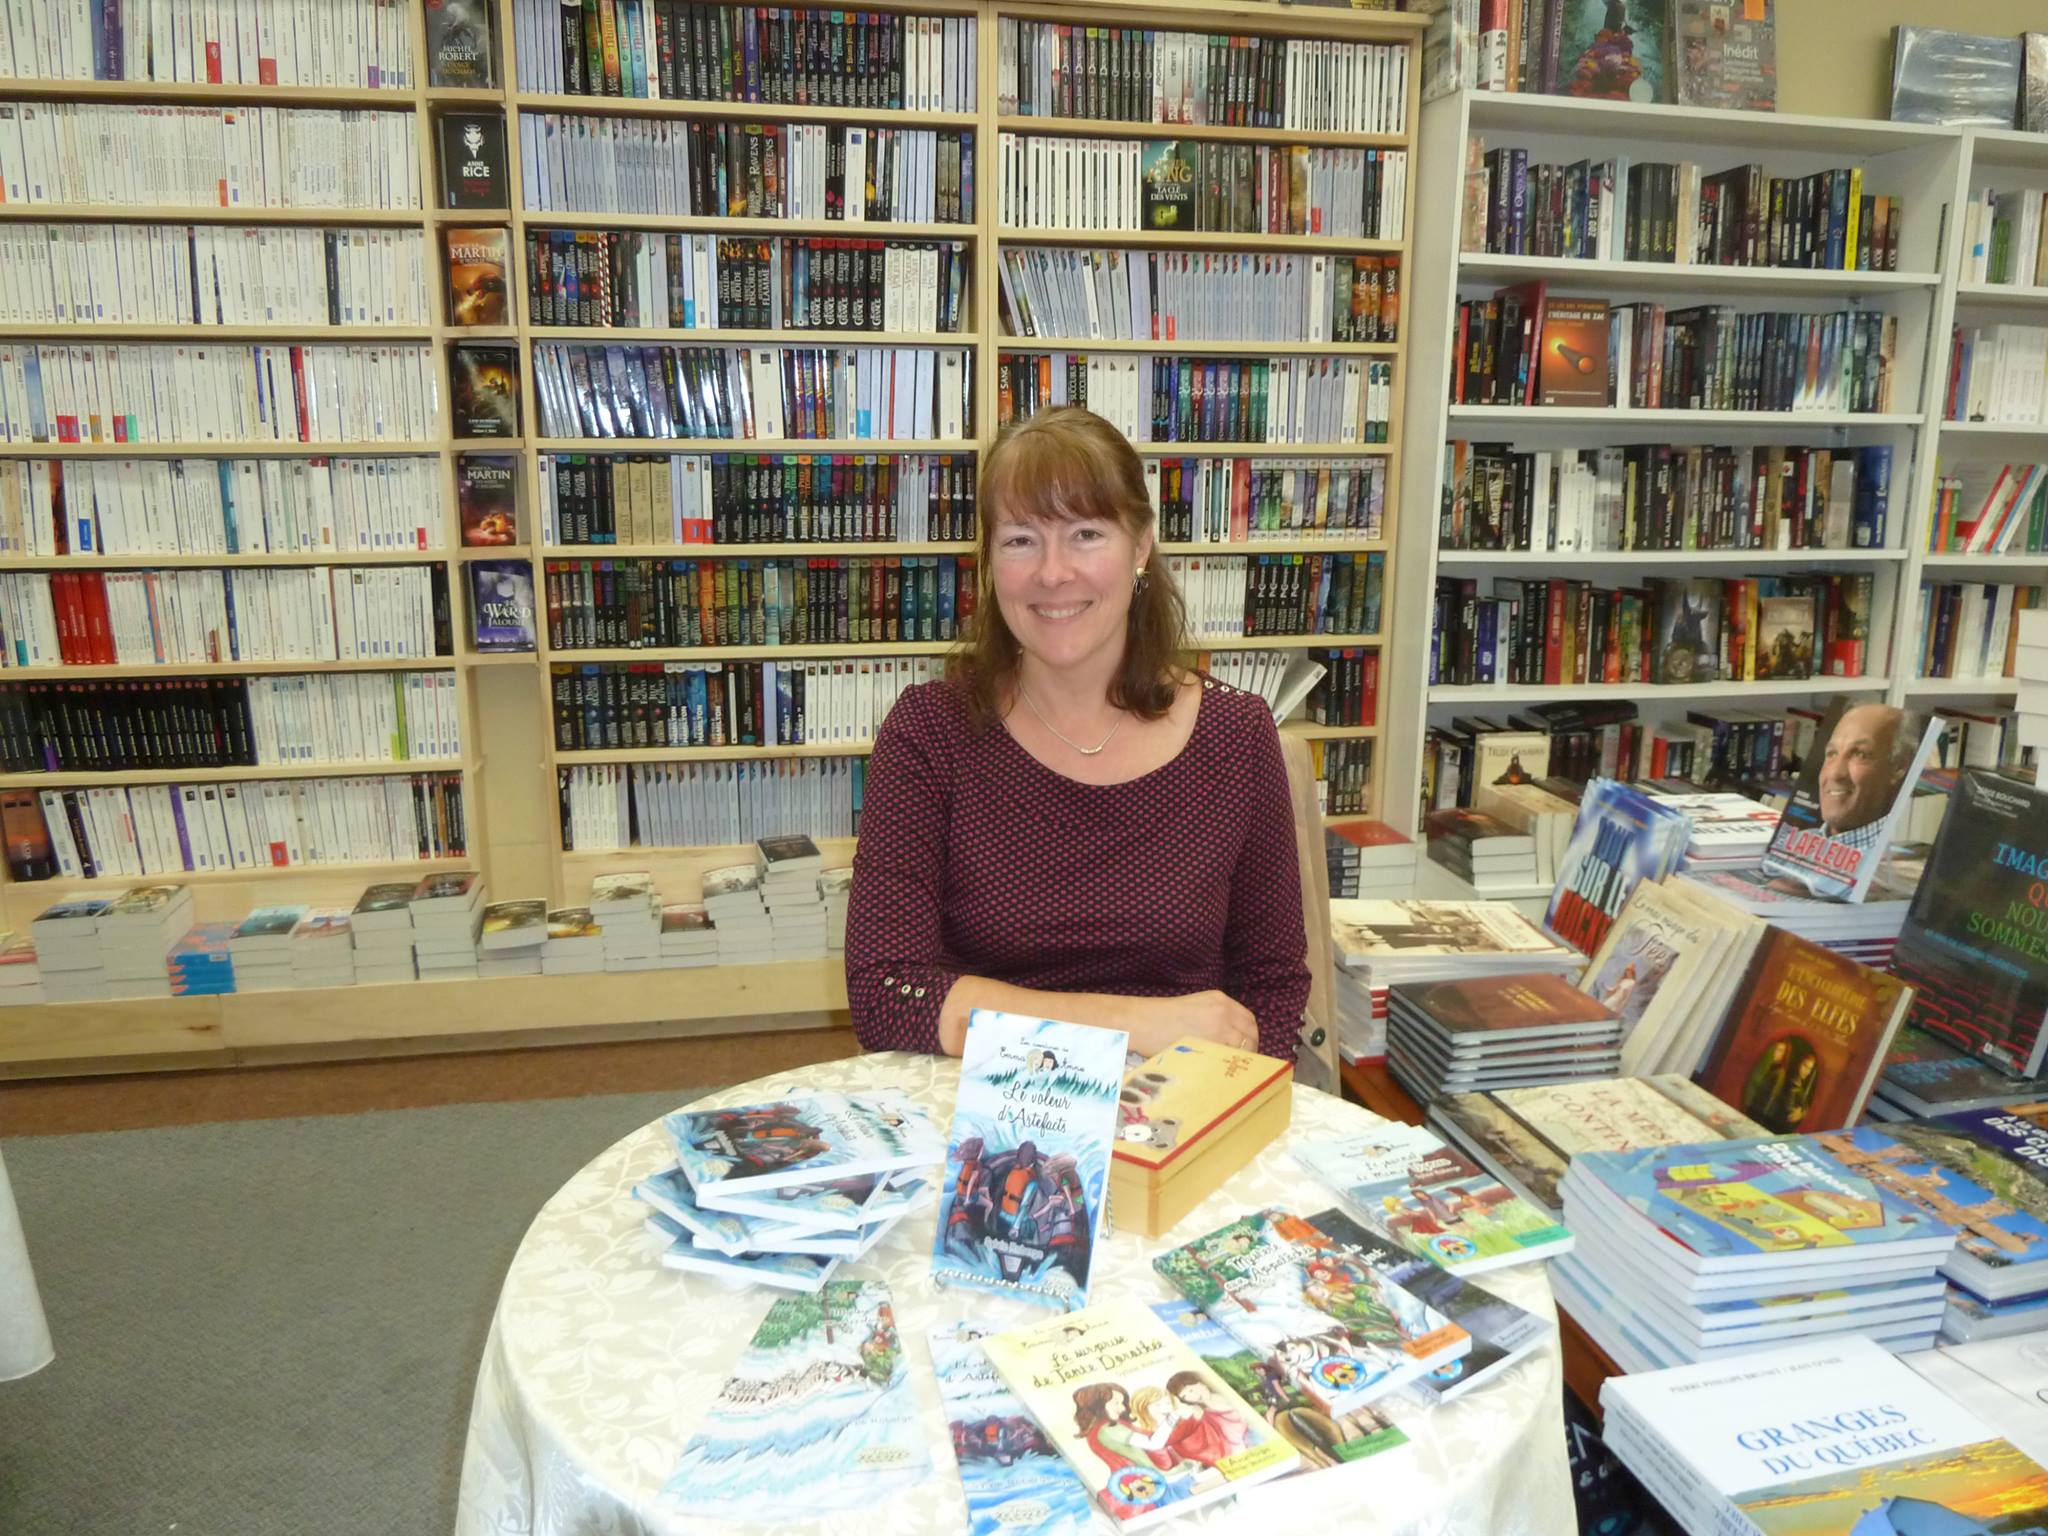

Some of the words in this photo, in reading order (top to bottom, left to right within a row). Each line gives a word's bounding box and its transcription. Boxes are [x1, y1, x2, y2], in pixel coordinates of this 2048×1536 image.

[679, 15, 688, 54] CAPURE
[438, 52, 477, 61] ROBERT
[1723, 43, 1759, 60] Inédit
[749, 136, 760, 175] RAVENS
[765, 138, 775, 177] RAVENS
[462, 166, 490, 178] RICE
[1147, 165, 1193, 183] KING
[451, 247, 507, 260] MARTIN
[761, 268, 770, 306] FLAMME
[1386, 269, 1395, 294] SANG
[1000, 366, 1009, 390] SANG
[467, 469, 511, 480] MARTIN
[484, 602, 531, 618] WARD
[670, 706, 678, 743] HAMILTON
[696, 704, 704, 742] HAMILTON
[1784, 826, 1862, 873] LAFLEUR
[1573, 854, 1611, 908] SUR
[2028, 882, 2048, 908] Q
[1776, 980, 1808, 1009] DES
[1811, 997, 1860, 1036] ELFES
[1003, 1082, 1027, 1101] Le
[1031, 1085, 1072, 1109] voleur
[997, 1107, 1067, 1138] d'Artefacts
[1983, 1116, 2029, 1138] DES
[1075, 1335, 1129, 1358] surprise
[1033, 1374, 1052, 1388] de
[1050, 1363, 1097, 1384] Tante
[1098, 1340, 1167, 1370] Dorothée
[1736, 1403, 1908, 1452] GRANGES
[1761, 1450, 1812, 1475] DU
[1813, 1427, 1937, 1470] QUÉBEC
